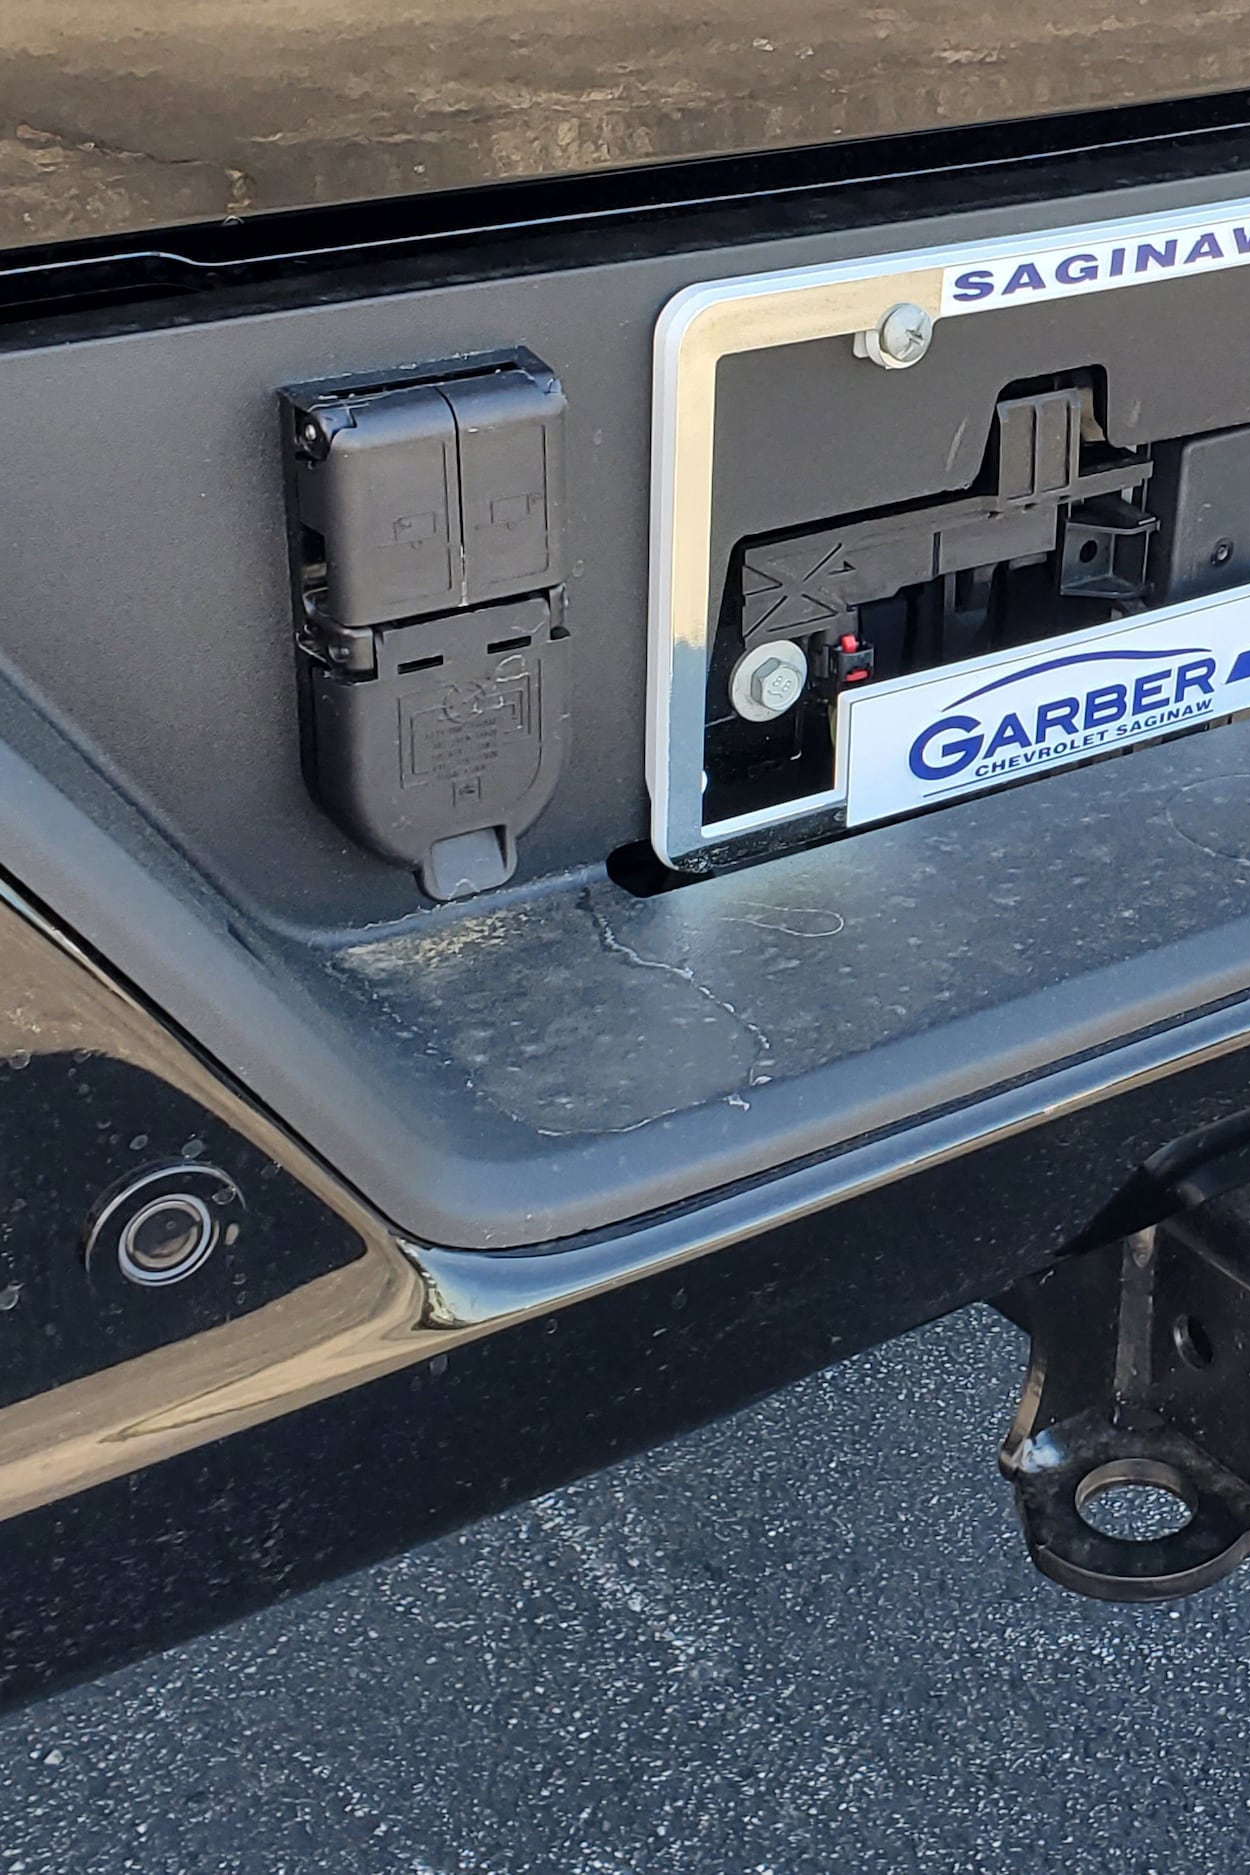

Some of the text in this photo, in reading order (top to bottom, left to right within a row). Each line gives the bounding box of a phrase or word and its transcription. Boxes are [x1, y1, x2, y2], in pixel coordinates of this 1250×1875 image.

[908, 656, 1217, 781] GARBER
[974, 698, 1213, 777] CHEVROLET SAGINAW
